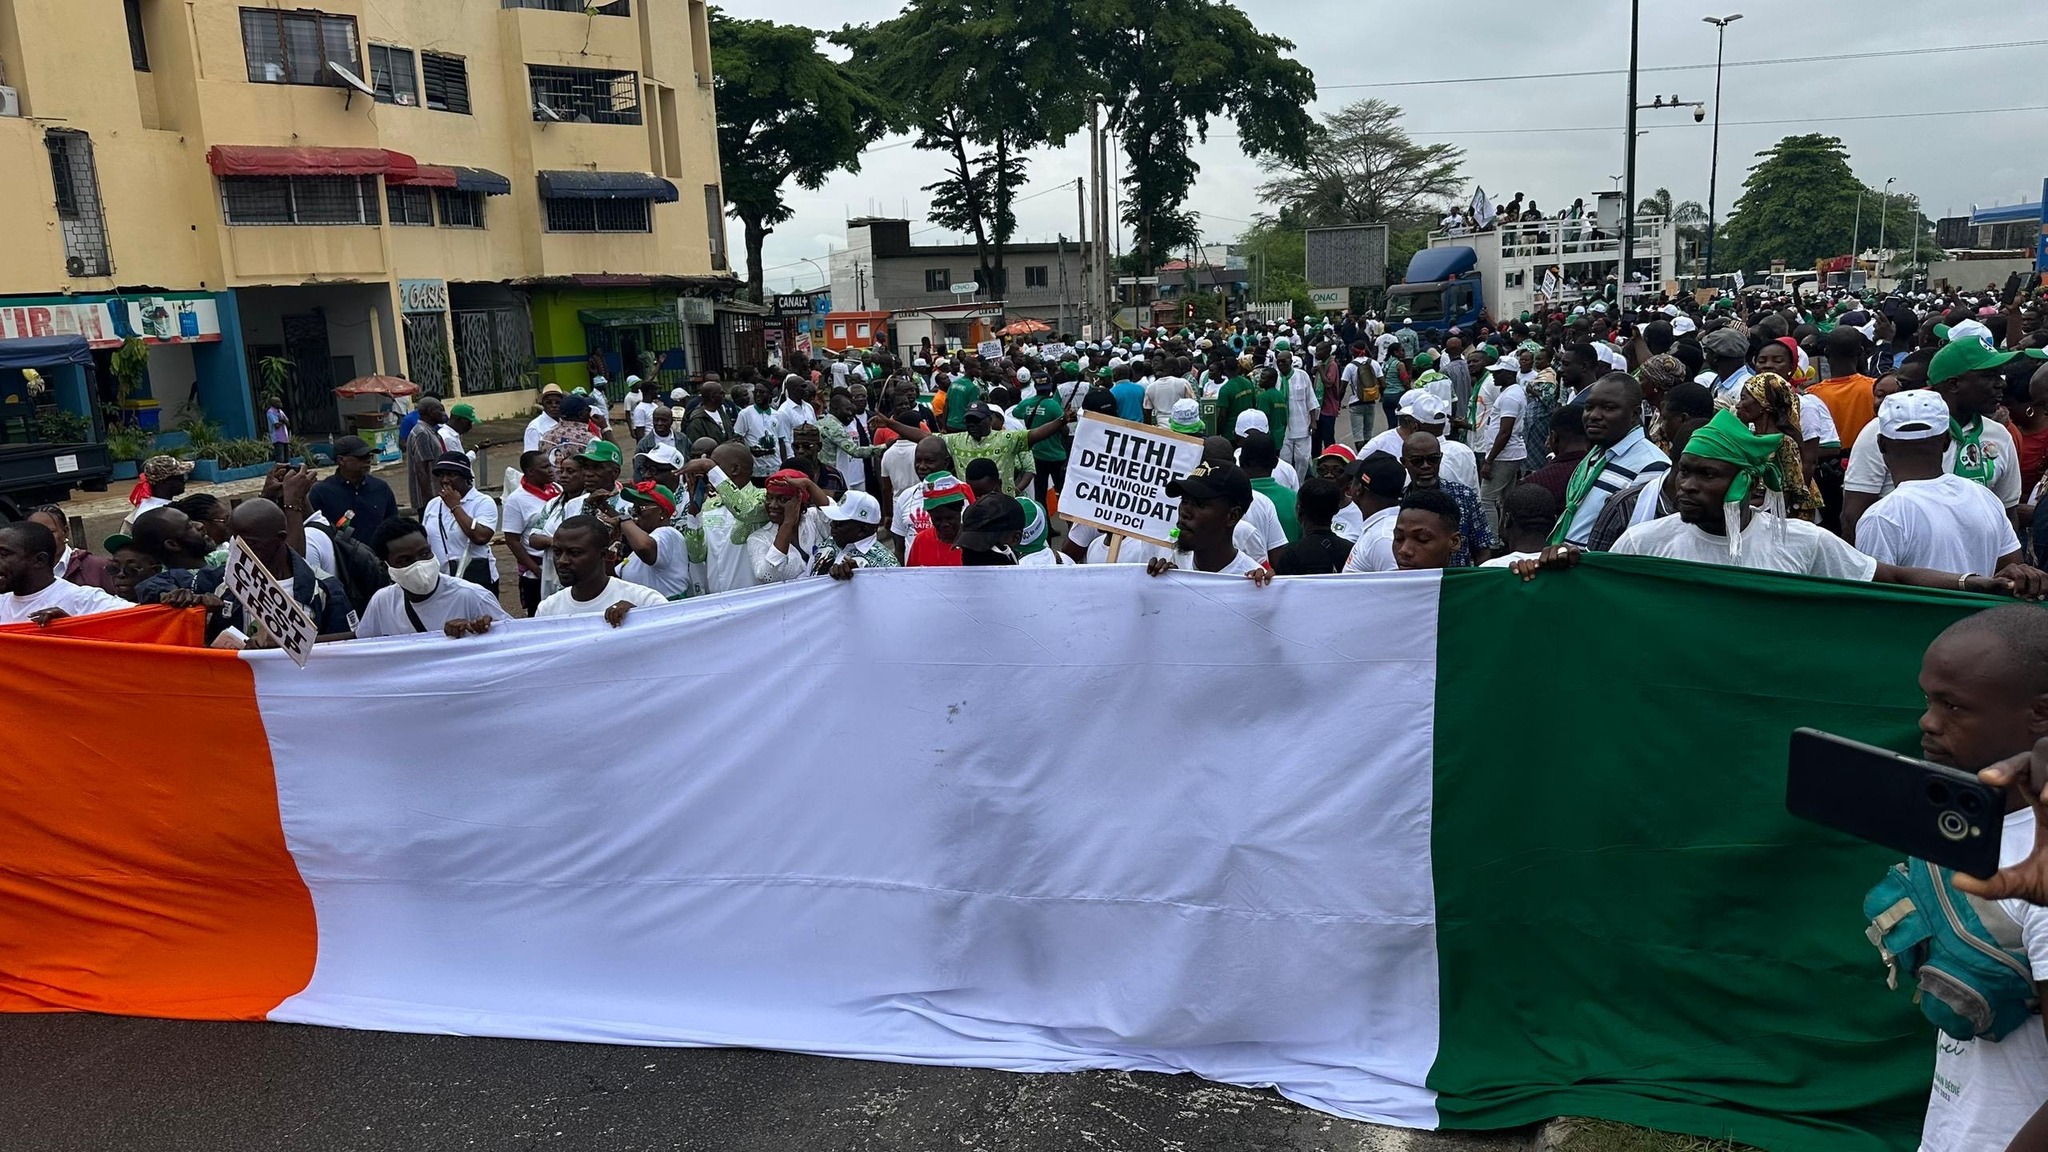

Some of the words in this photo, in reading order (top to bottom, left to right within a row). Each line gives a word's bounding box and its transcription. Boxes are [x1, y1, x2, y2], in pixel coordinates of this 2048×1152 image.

[779, 296, 808, 308] CANAL+
[1313, 293, 1338, 301] ONACI
[1104, 429, 1176, 469] TITHI
[1075, 481, 1177, 523] CANDIDAT
[1101, 475, 1158, 499] L'UNIQUE
[1094, 507, 1112, 521] DU
[1114, 512, 1144, 530] PDCI
[236, 544, 306, 629] TROP
[232, 572, 301, 655] TROP
